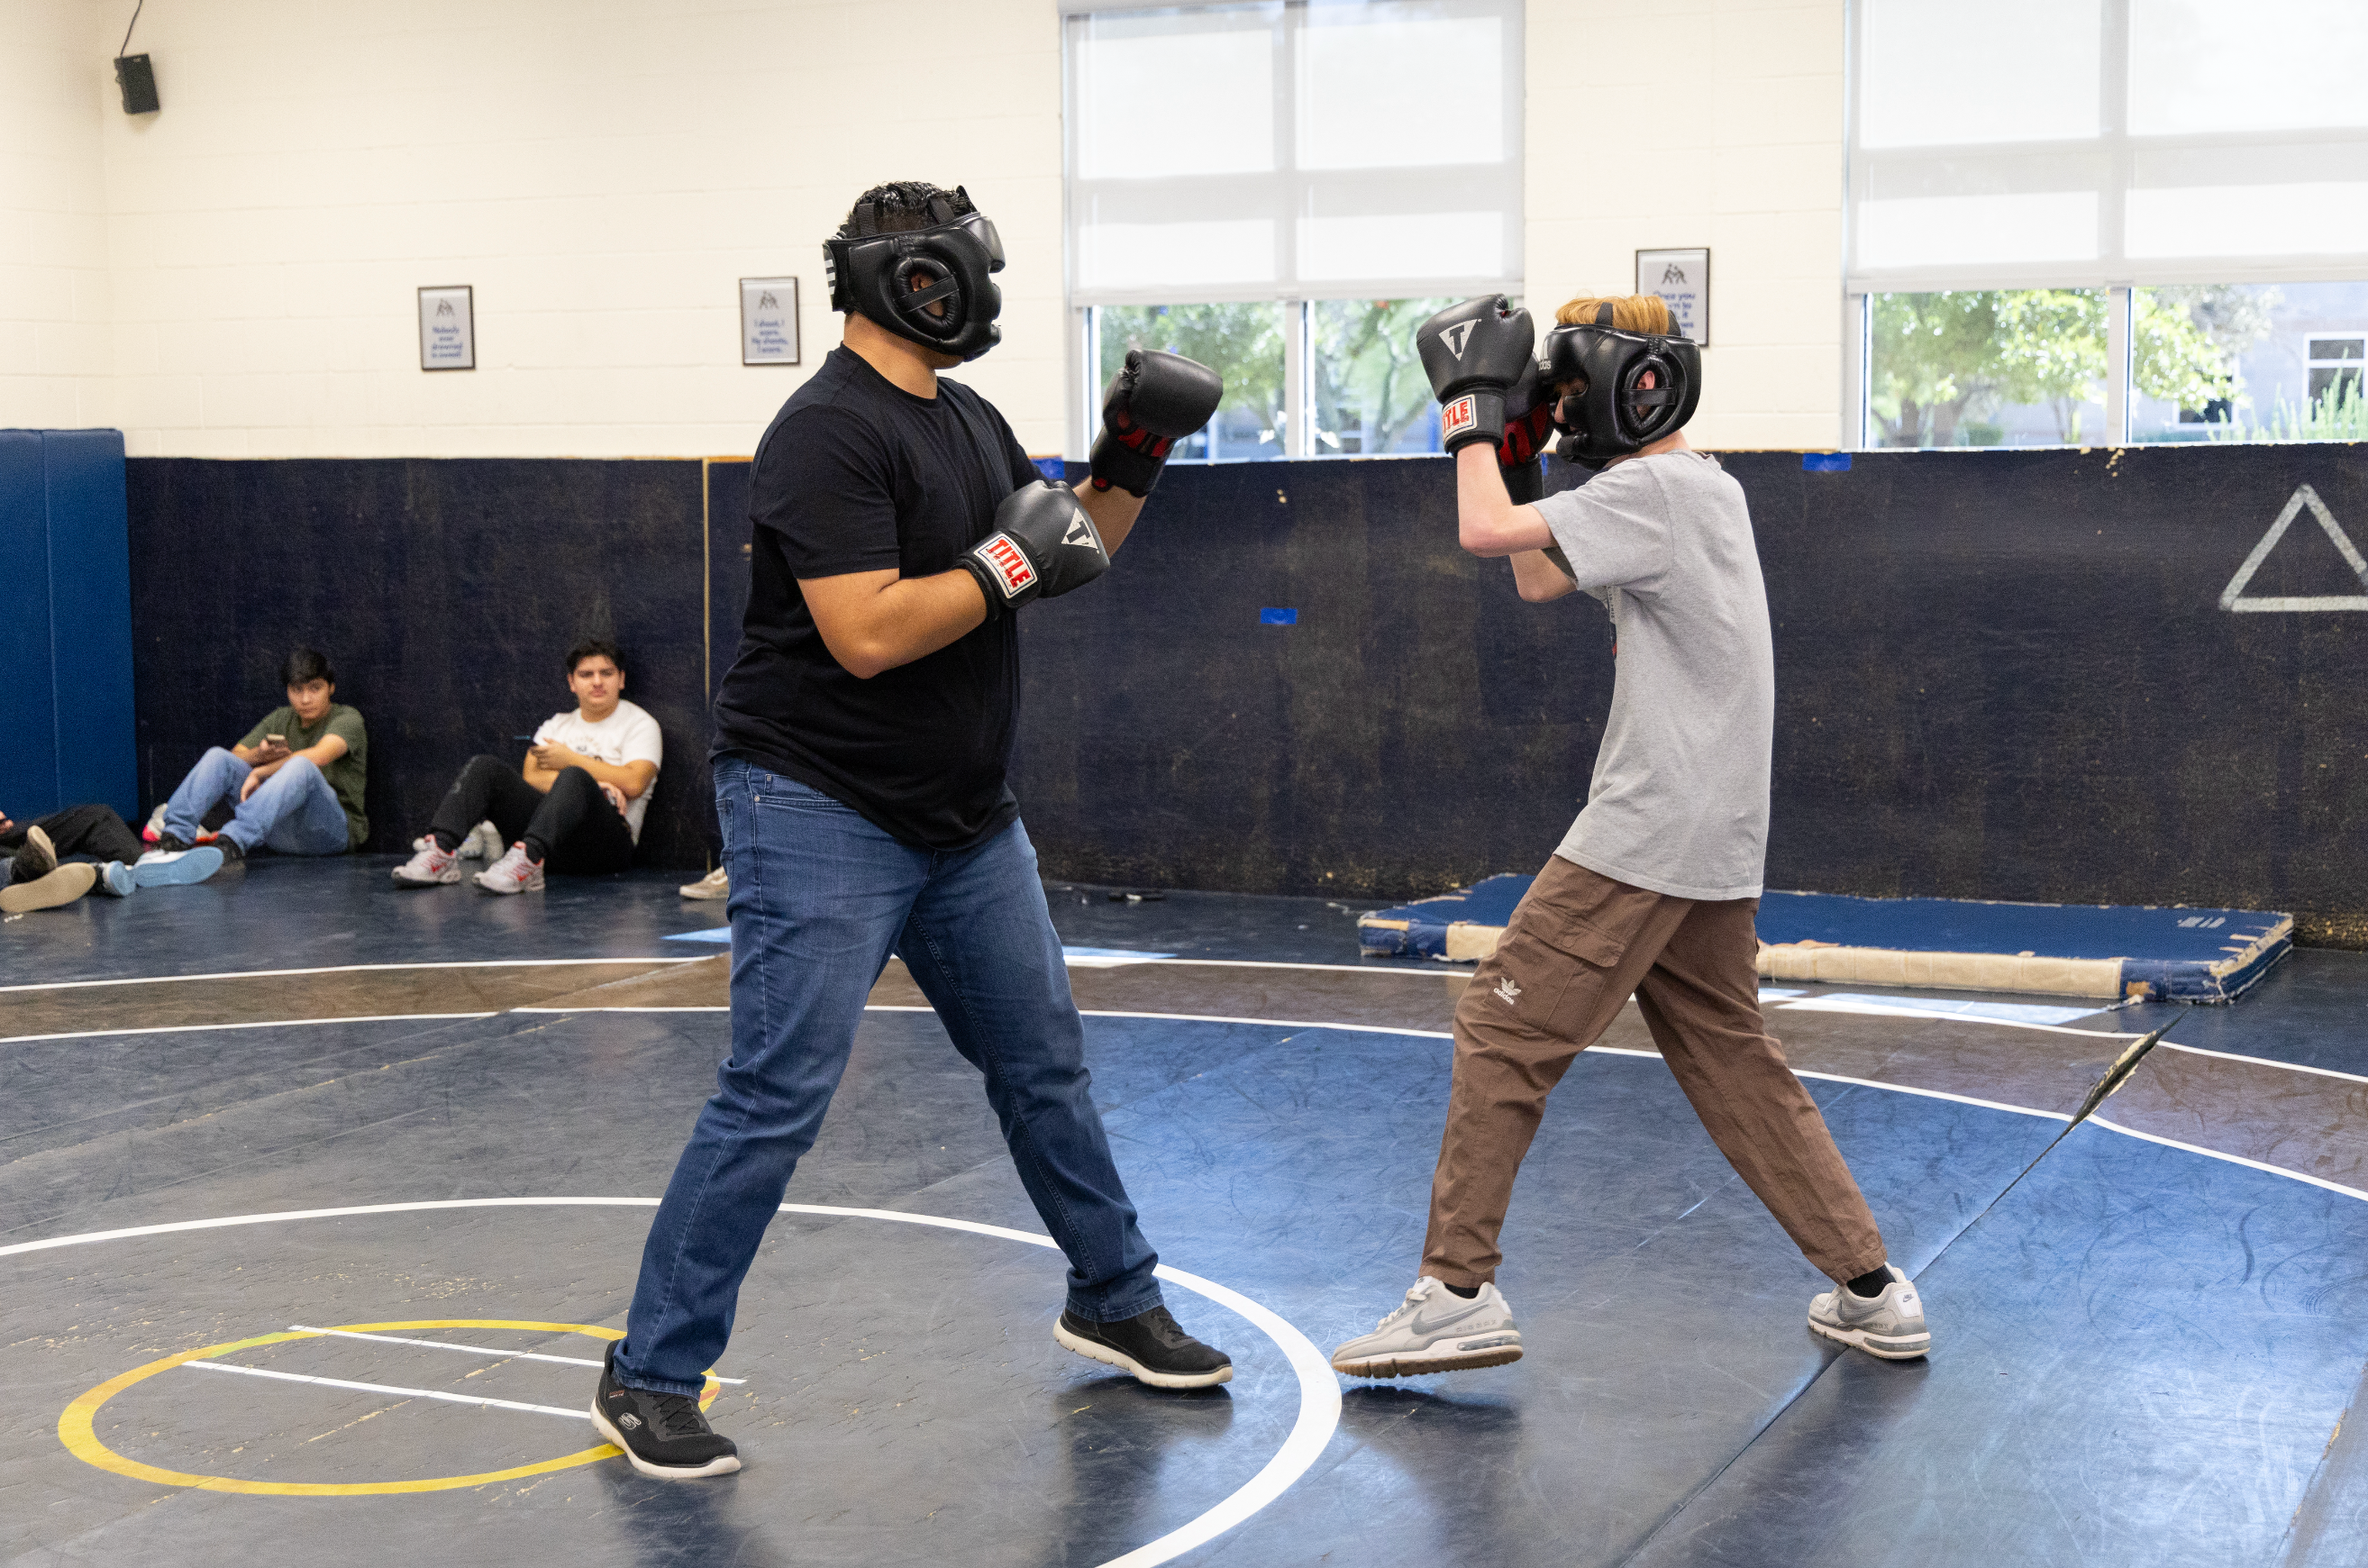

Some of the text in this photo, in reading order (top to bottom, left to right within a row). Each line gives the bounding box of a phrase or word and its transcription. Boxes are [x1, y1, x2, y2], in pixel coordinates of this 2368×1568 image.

[1678, 293, 1695, 301] you
[1443, 401, 1470, 434] ITLE
[986, 539, 1032, 588] TITLE
[1493, 988, 1515, 1006] adidas
